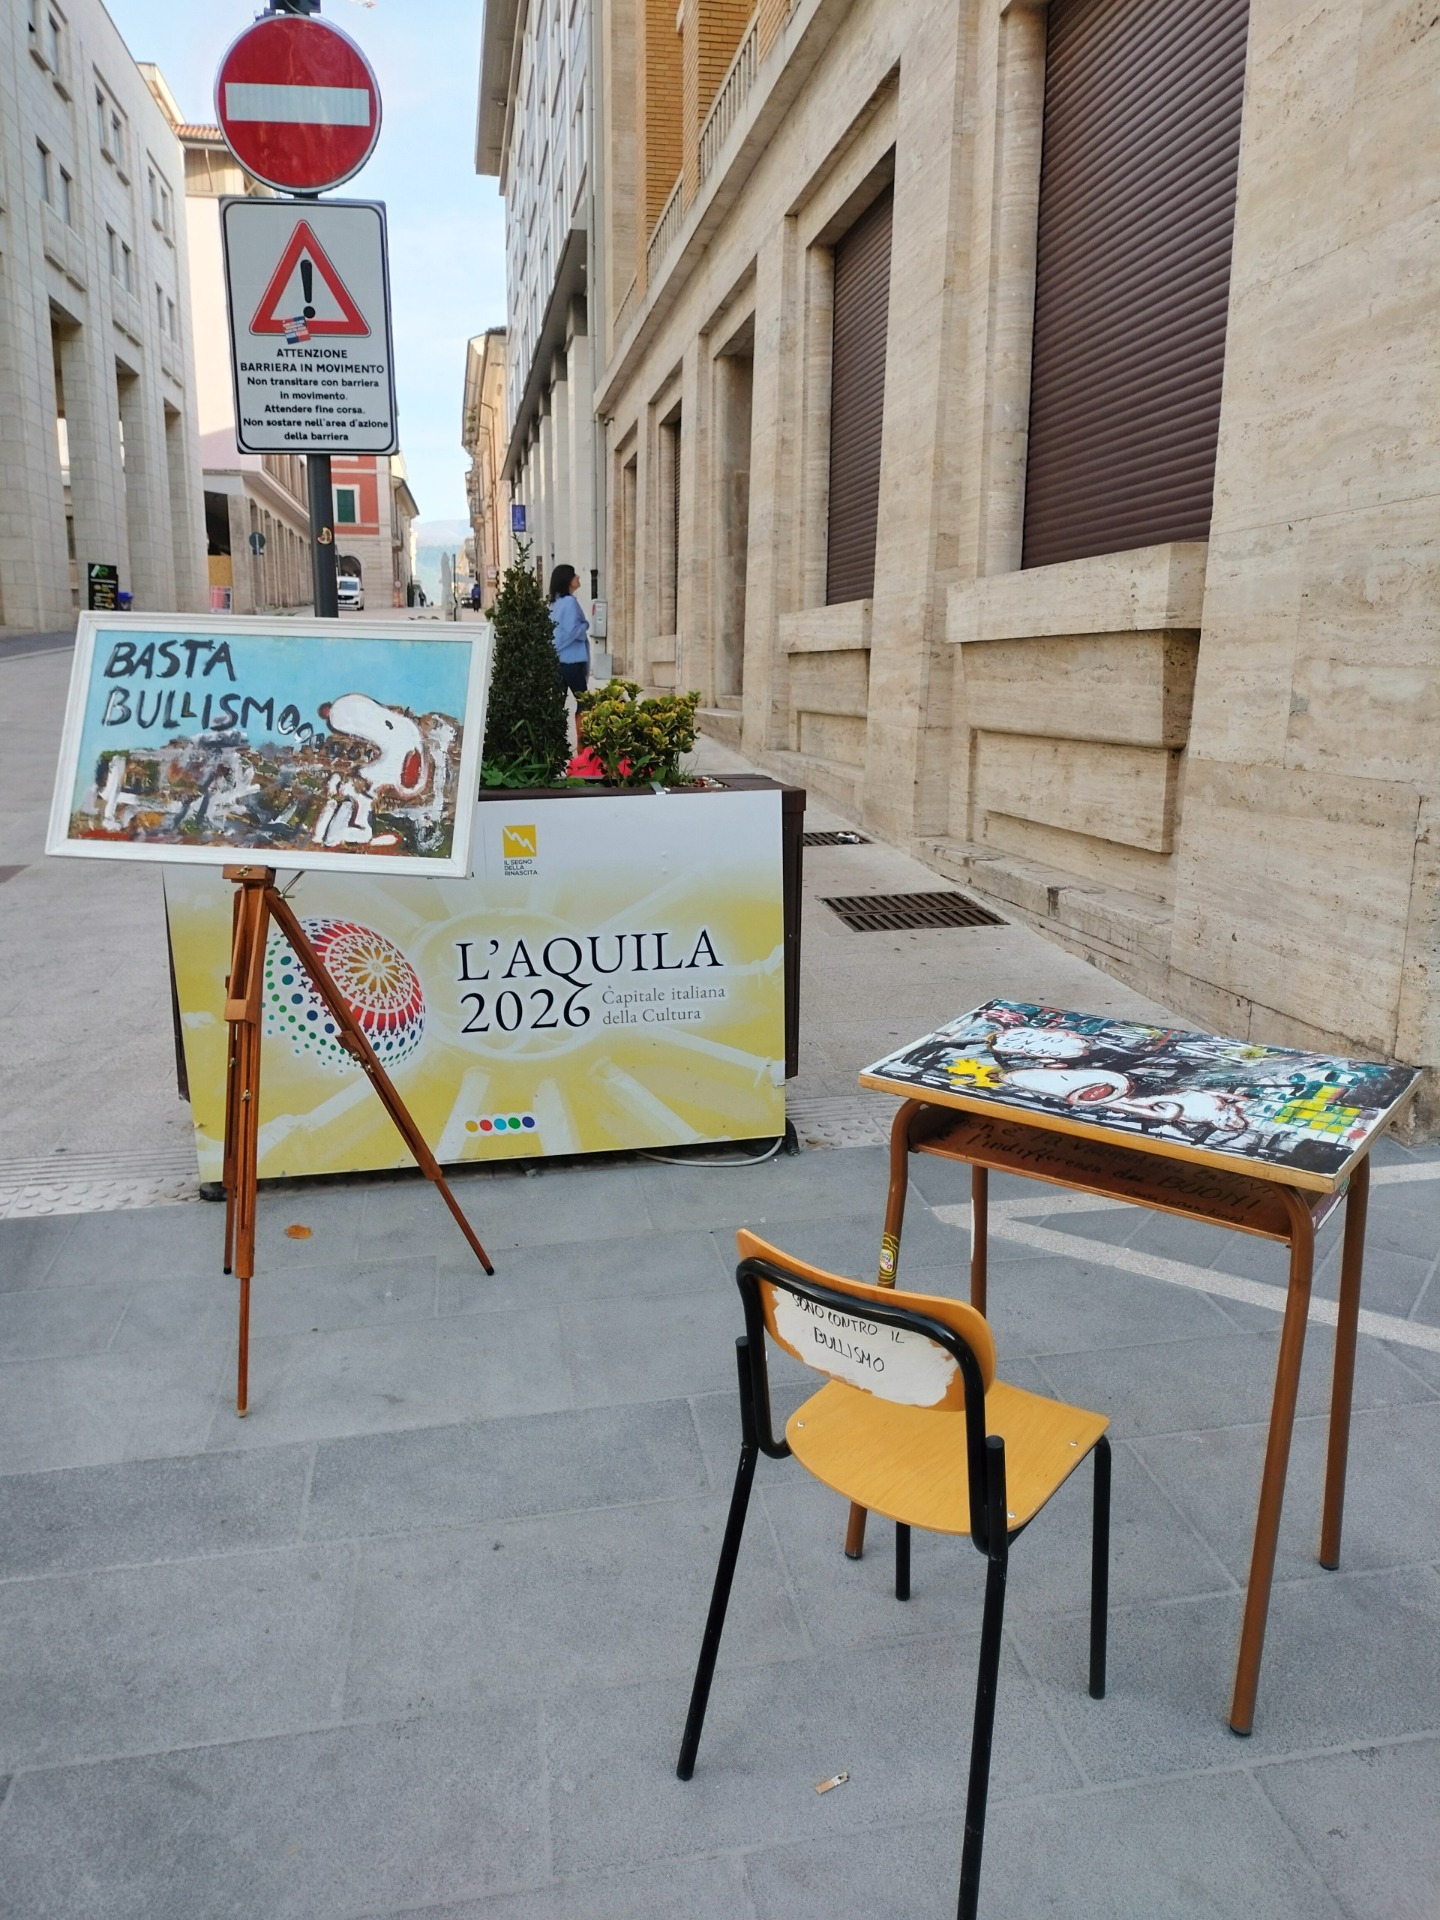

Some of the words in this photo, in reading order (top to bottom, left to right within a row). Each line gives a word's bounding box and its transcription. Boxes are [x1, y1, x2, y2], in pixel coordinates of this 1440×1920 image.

[277, 348, 348, 358] ATTENZIONE
[240, 362, 297, 372] BARRIERA
[301, 363, 313, 372] IN
[316, 364, 384, 373] MOVIMENTO
[247, 377, 267, 386] Non
[271, 377, 318, 387] transitare
[321, 379, 339, 387] con
[341, 378, 379, 387] barriera
[280, 391, 289, 400] in
[292, 391, 348, 401] movimento.
[264, 404, 312, 413] Attendere
[315, 405, 334, 414] fine
[336, 406, 365, 414] corsa.
[243, 418, 263, 426] Non
[266, 419, 301, 427] sostare
[304, 418, 346, 427] nell'area
[349, 418, 389, 428] d'azione
[284, 432, 308, 440] della
[311, 432, 349, 441] barriera
[104, 639, 237, 682] BASTA
[455, 928, 724, 990] L'AQUILA
[602, 987, 665, 1008] Capitale
[671, 985, 726, 1000] italiana
[460, 986, 592, 1034] 2026
[602, 1010, 638, 1025] della
[642, 1007, 702, 1022] Cultura
[792, 1293, 825, 1319] SONO
[828, 1311, 878, 1336] CONTRO
[891, 1330, 905, 1344] IL
[813, 1326, 885, 1373] BULLISMO
